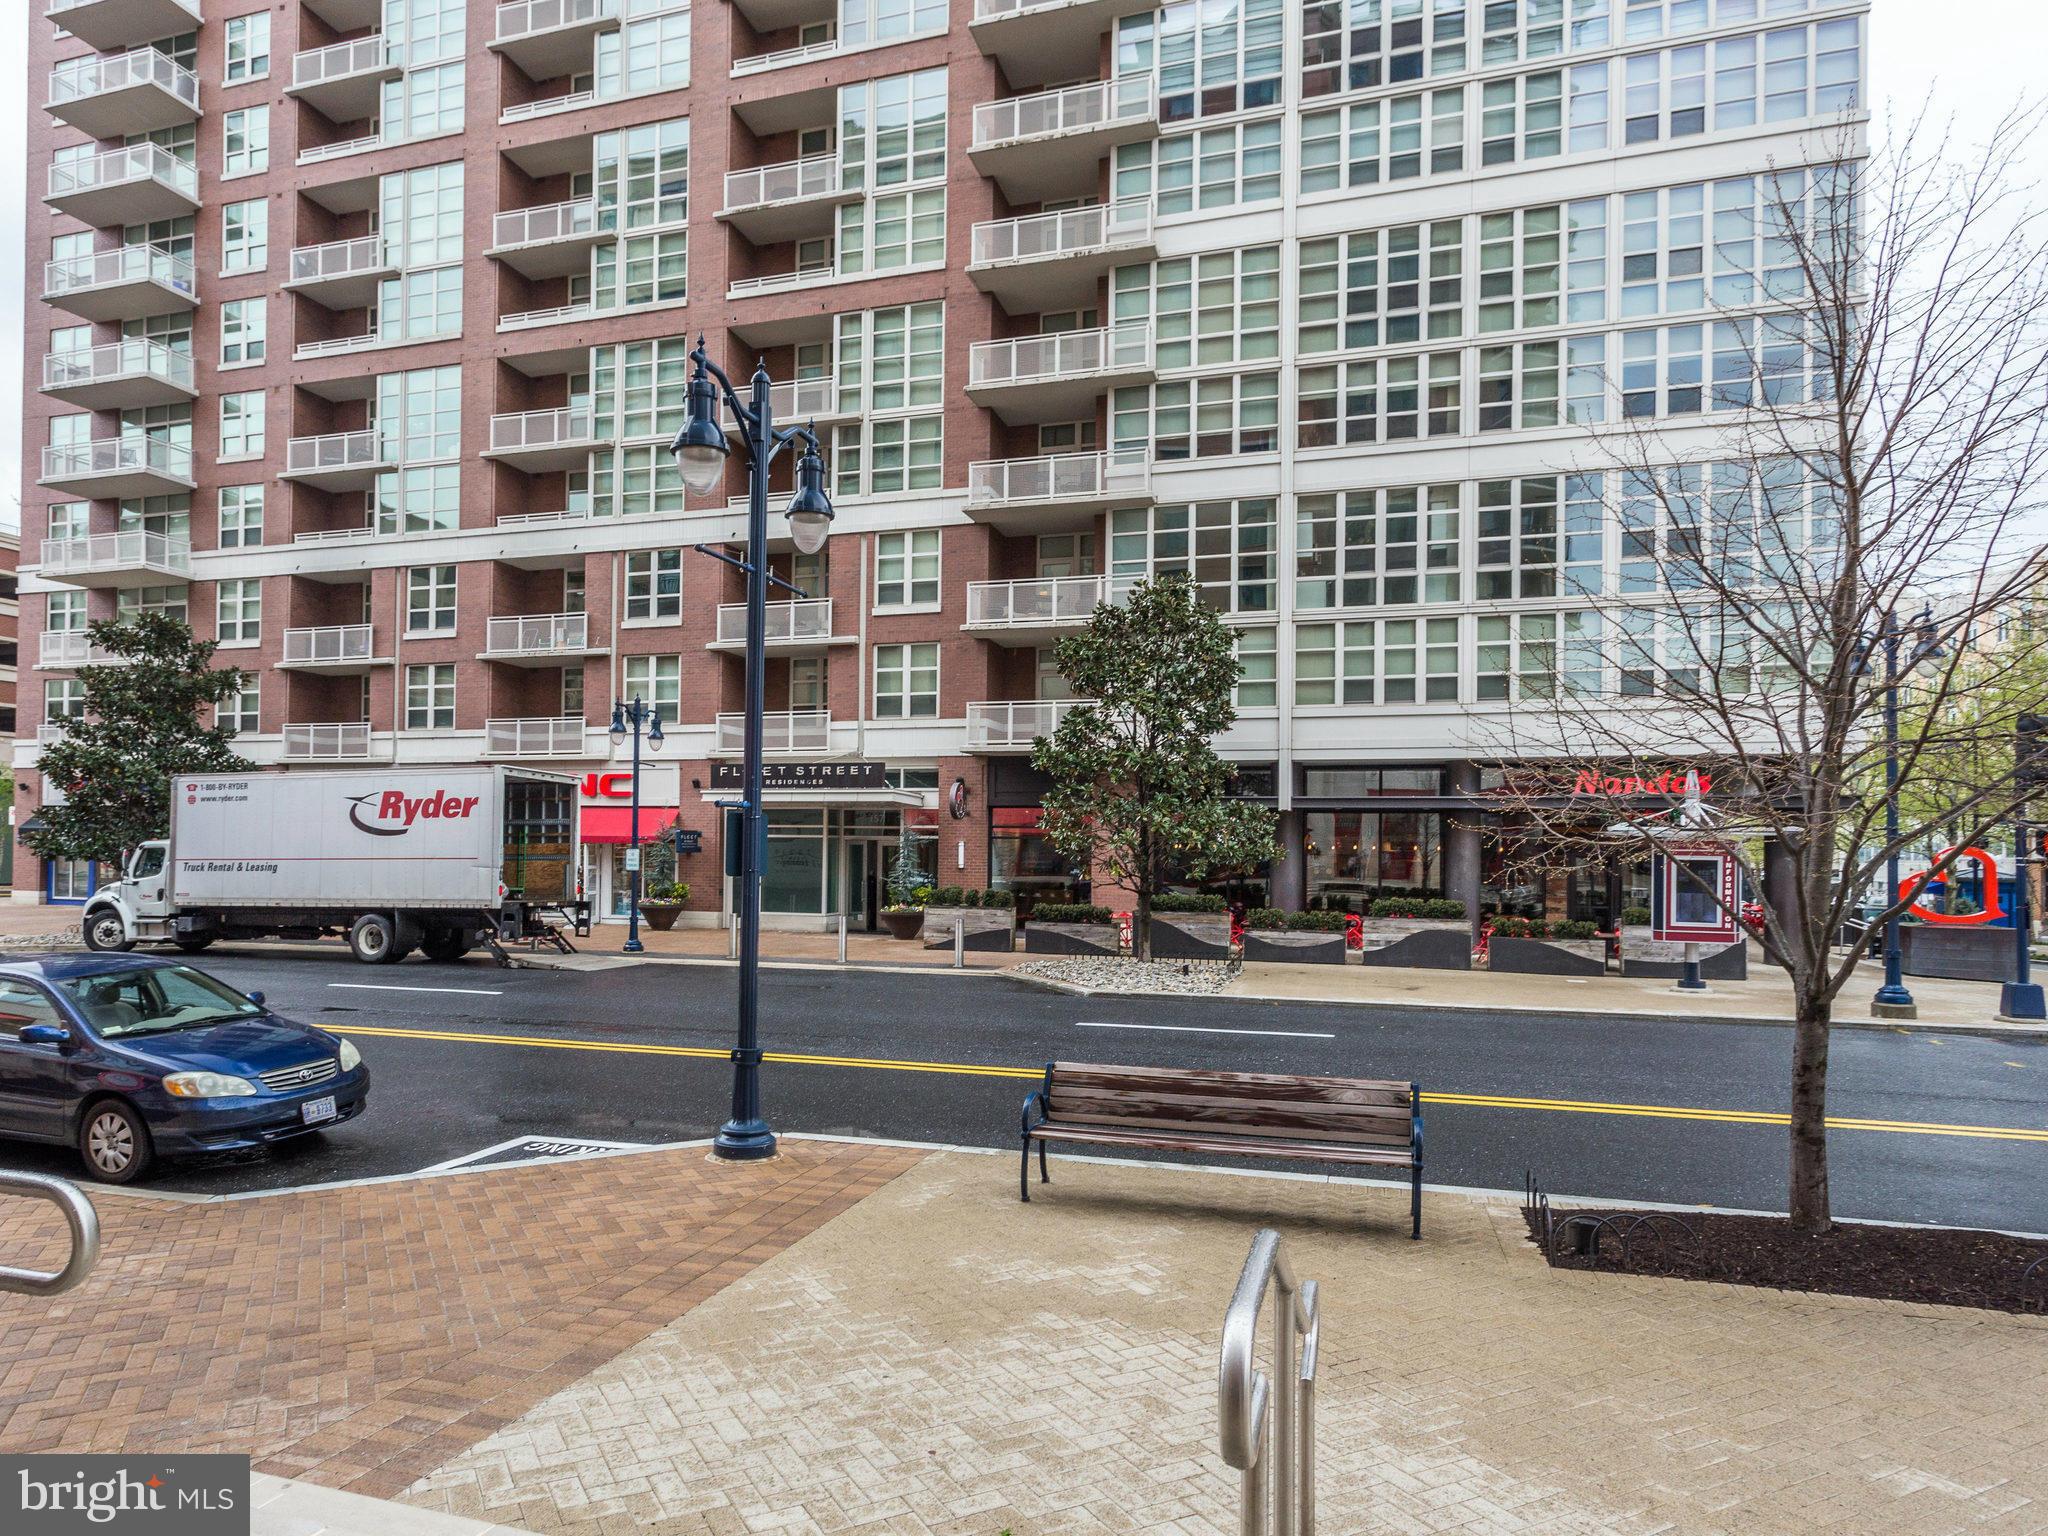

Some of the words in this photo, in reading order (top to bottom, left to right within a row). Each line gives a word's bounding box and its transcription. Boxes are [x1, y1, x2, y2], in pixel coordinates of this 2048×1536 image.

[719, 766, 786, 777] FLET
[795, 765, 873, 776] STREET
[200, 782, 249, 791] 1-800-BY-RYDER
[200, 794, 248, 803] www.ryder.com
[378, 790, 480, 825] Ryder
[183, 862, 205, 872] Truck
[207, 862, 234, 872] Rental
[236, 862, 243, 872] &
[245, 862, 278, 874] Leasing
[1724, 855, 1732, 929] INFORMATON
